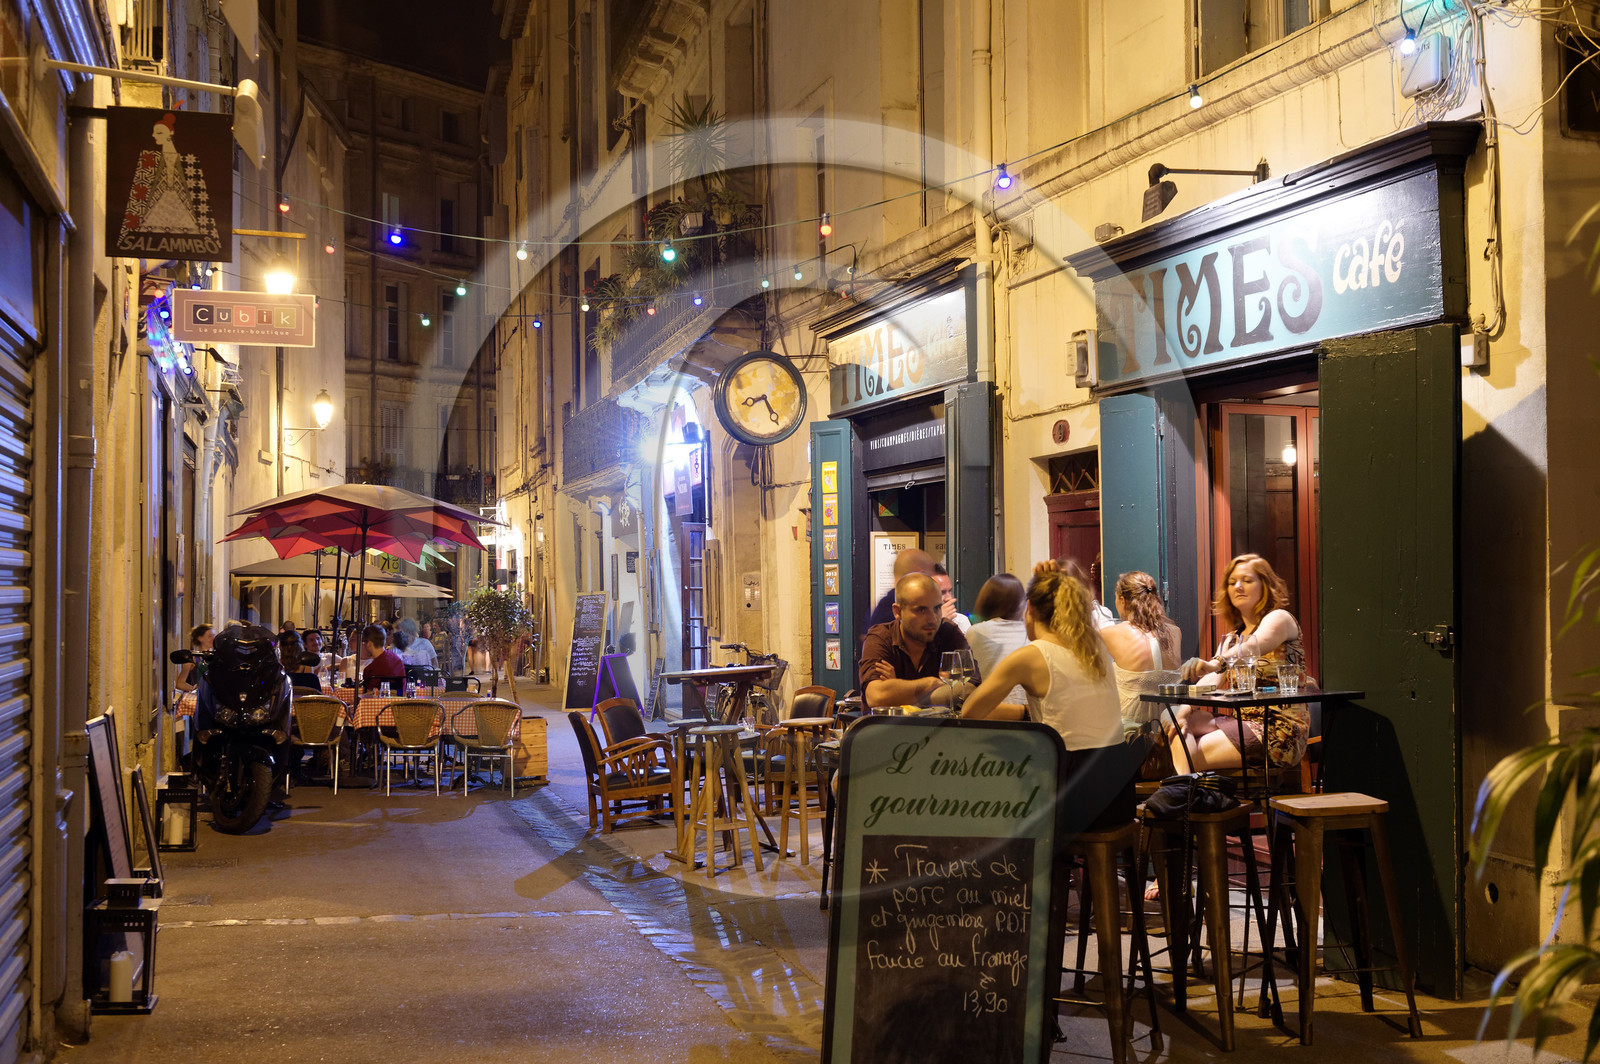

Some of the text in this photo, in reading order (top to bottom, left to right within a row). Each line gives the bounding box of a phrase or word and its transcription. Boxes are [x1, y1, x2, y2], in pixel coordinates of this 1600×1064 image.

[119, 235, 220, 255] SALAMMBÔ
[1110, 219, 1405, 374] TIMES café
[196, 307, 291, 325] Cubik
[213, 327, 290, 336] galerie-boutique
[883, 543, 906, 551] TIMES
[863, 785, 1041, 829] gourmand
[894, 844, 1021, 882] Travers de
[956, 888, 983, 905] au
[991, 883, 1031, 910] miel
[870, 906, 893, 928] et
[937, 951, 966, 968] au
[963, 991, 1008, 1019] 13,90
